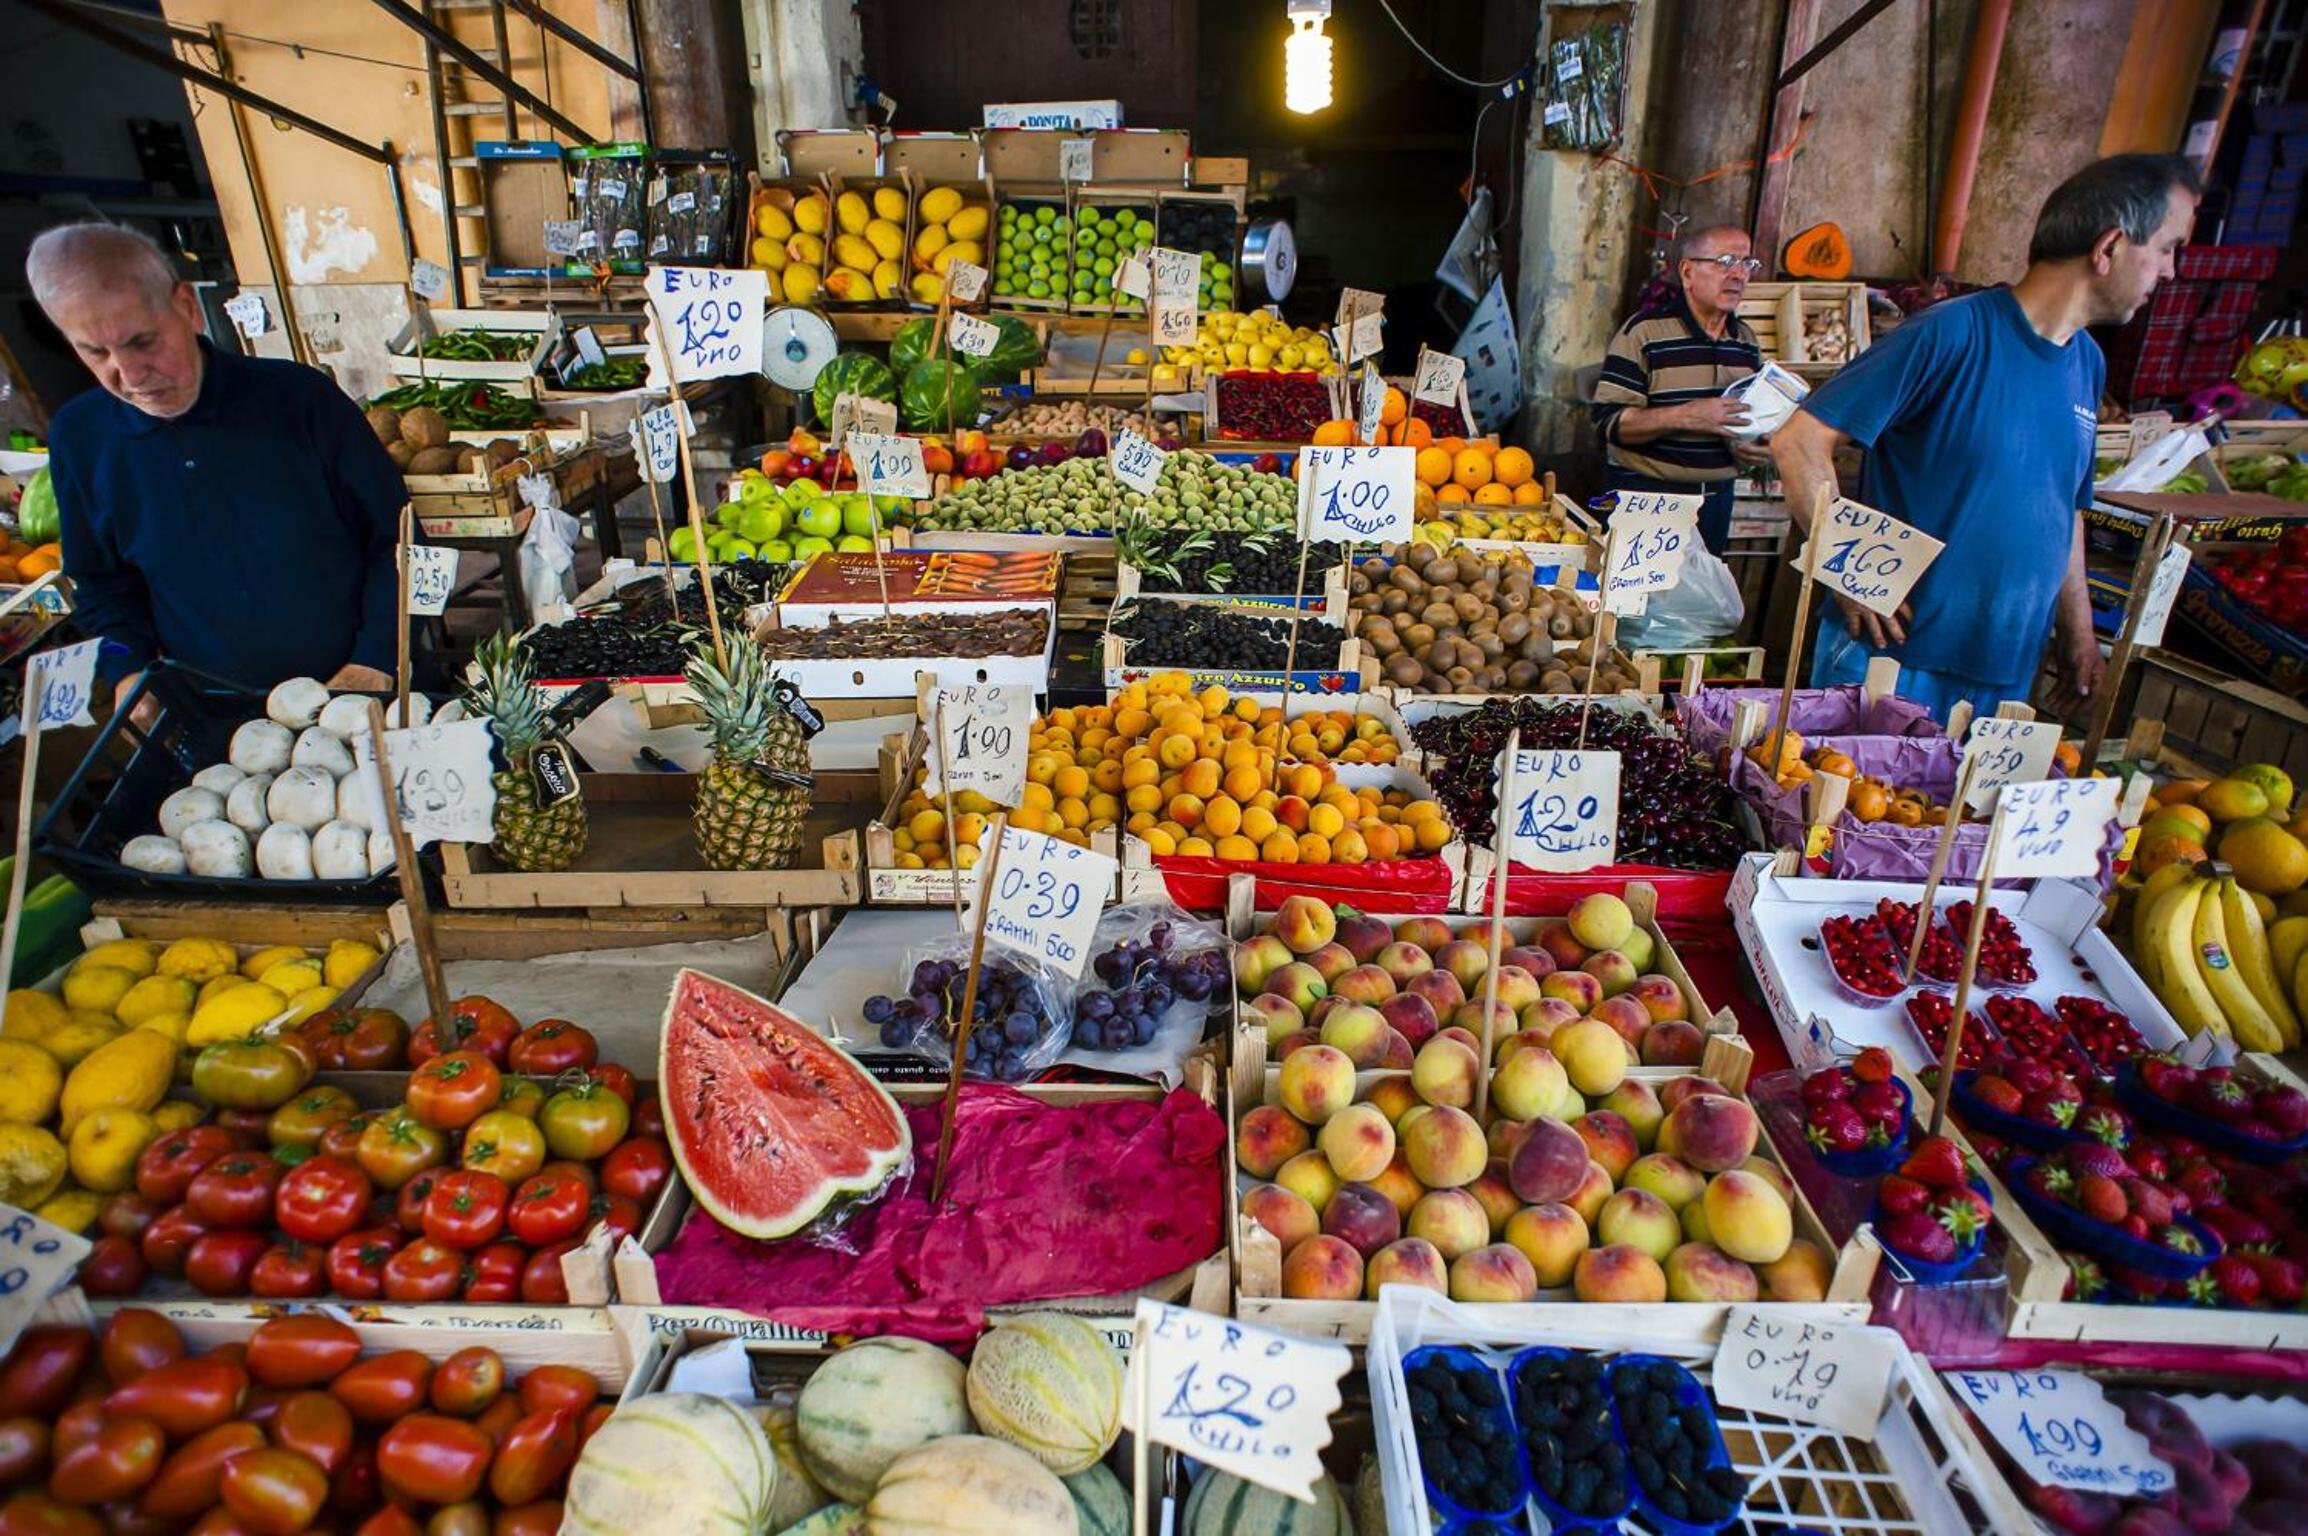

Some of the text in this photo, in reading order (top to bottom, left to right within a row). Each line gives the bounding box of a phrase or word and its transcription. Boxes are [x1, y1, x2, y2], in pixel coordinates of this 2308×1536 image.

[664, 268, 734, 292] EURO
[676, 300, 743, 355] 1.20
[1162, 310, 1191, 330] 1.60
[854, 435, 901, 447] EURO
[1309, 447, 1380, 470] EURO
[1320, 480, 1390, 521] 1.00
[1625, 495, 1680, 515] EURO
[1835, 506, 1911, 539] EURO
[2236, 522, 2283, 540] Gusto
[1620, 527, 1680, 571] 1.50
[1822, 538, 1902, 577] 1.60
[414, 567, 449, 599] 2.50
[1648, 570, 1666, 584] 500
[937, 686, 1000, 706] EURO
[1978, 721, 2033, 741] EURO
[1516, 748, 1581, 783] EURO
[2006, 781, 2096, 812] EURO
[1515, 790, 1598, 837] 1.20
[1001, 868, 1080, 918] 0.39
[1046, 933, 1076, 961] 500
[1154, 1308, 1286, 1357] EURO
[1743, 1313, 1834, 1343] EURO
[1162, 1361, 1296, 1427] 1.20
[1961, 1371, 2058, 1404] EURO
